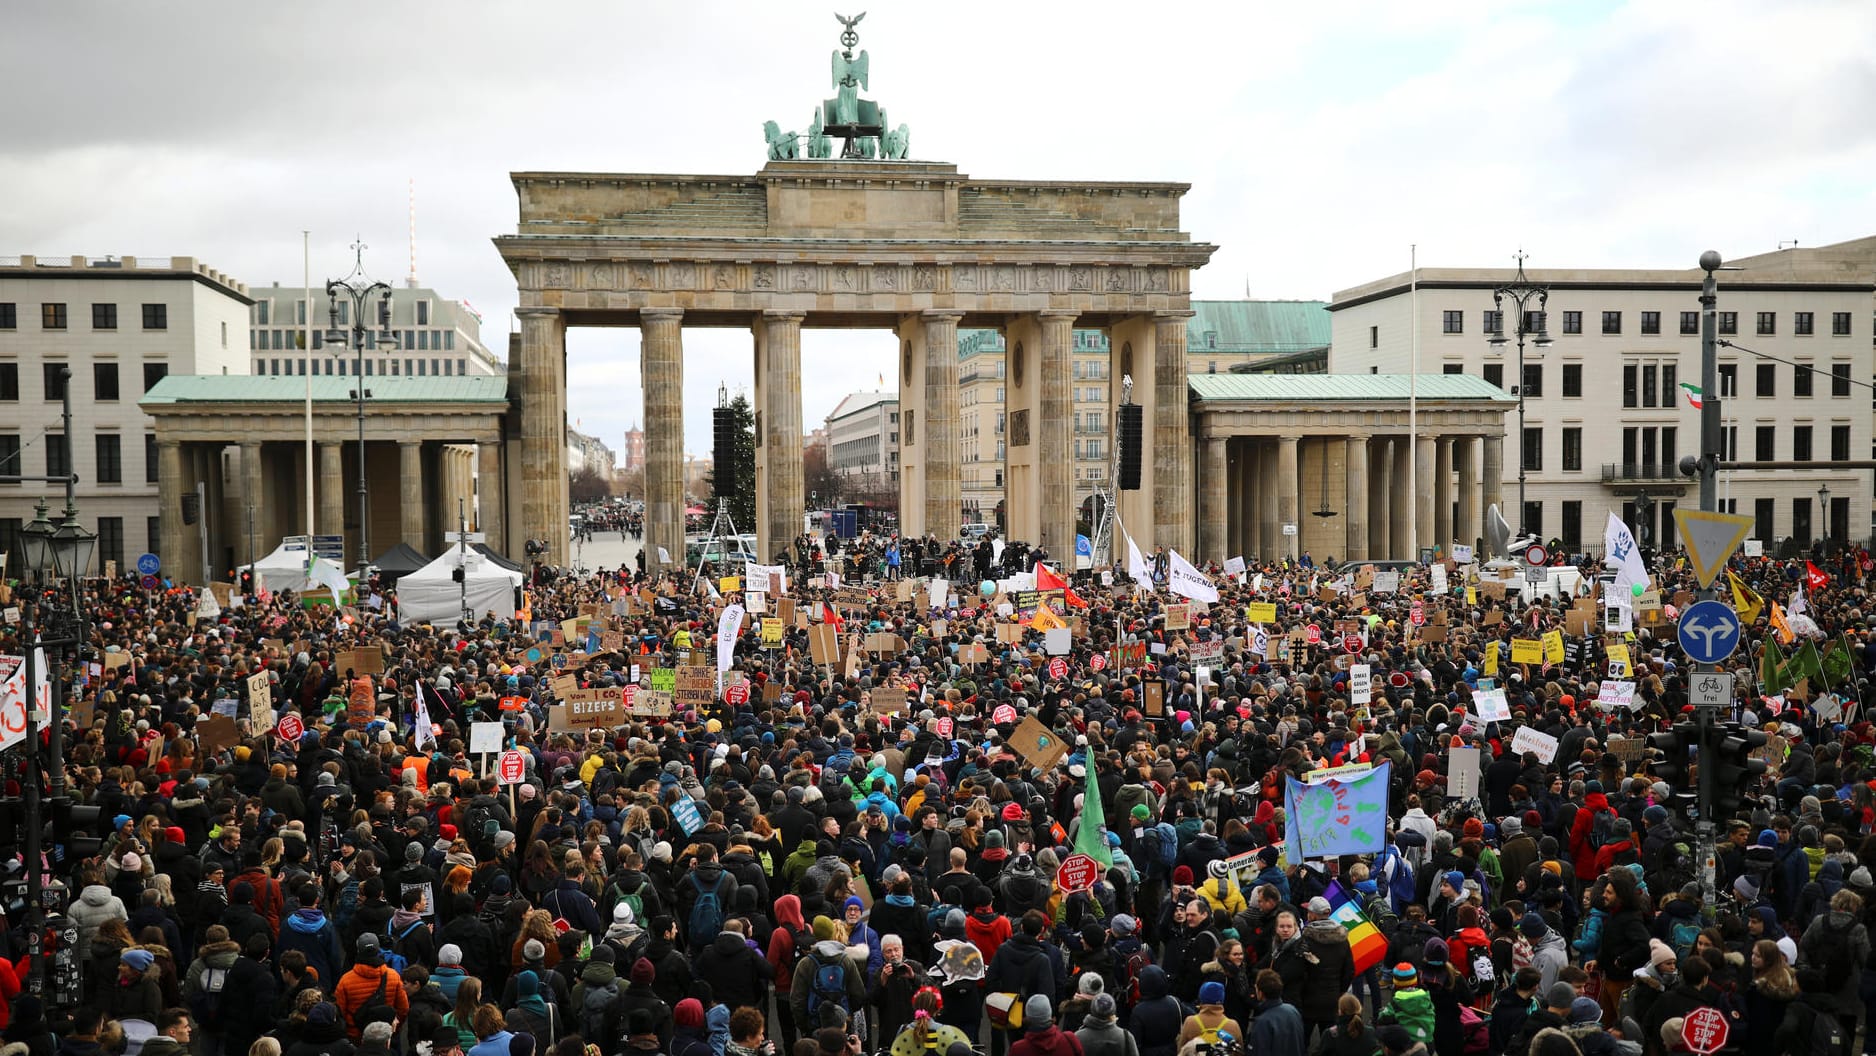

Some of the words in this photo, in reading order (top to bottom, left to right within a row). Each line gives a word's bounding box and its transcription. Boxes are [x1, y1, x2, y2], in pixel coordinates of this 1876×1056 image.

[573, 701, 615, 714] BIZEPS
[1067, 858, 1086, 867] STOP
[1068, 871, 1087, 880] STOP
[1698, 1012, 1719, 1022] STOP
[1695, 1027, 1715, 1037] STOP
